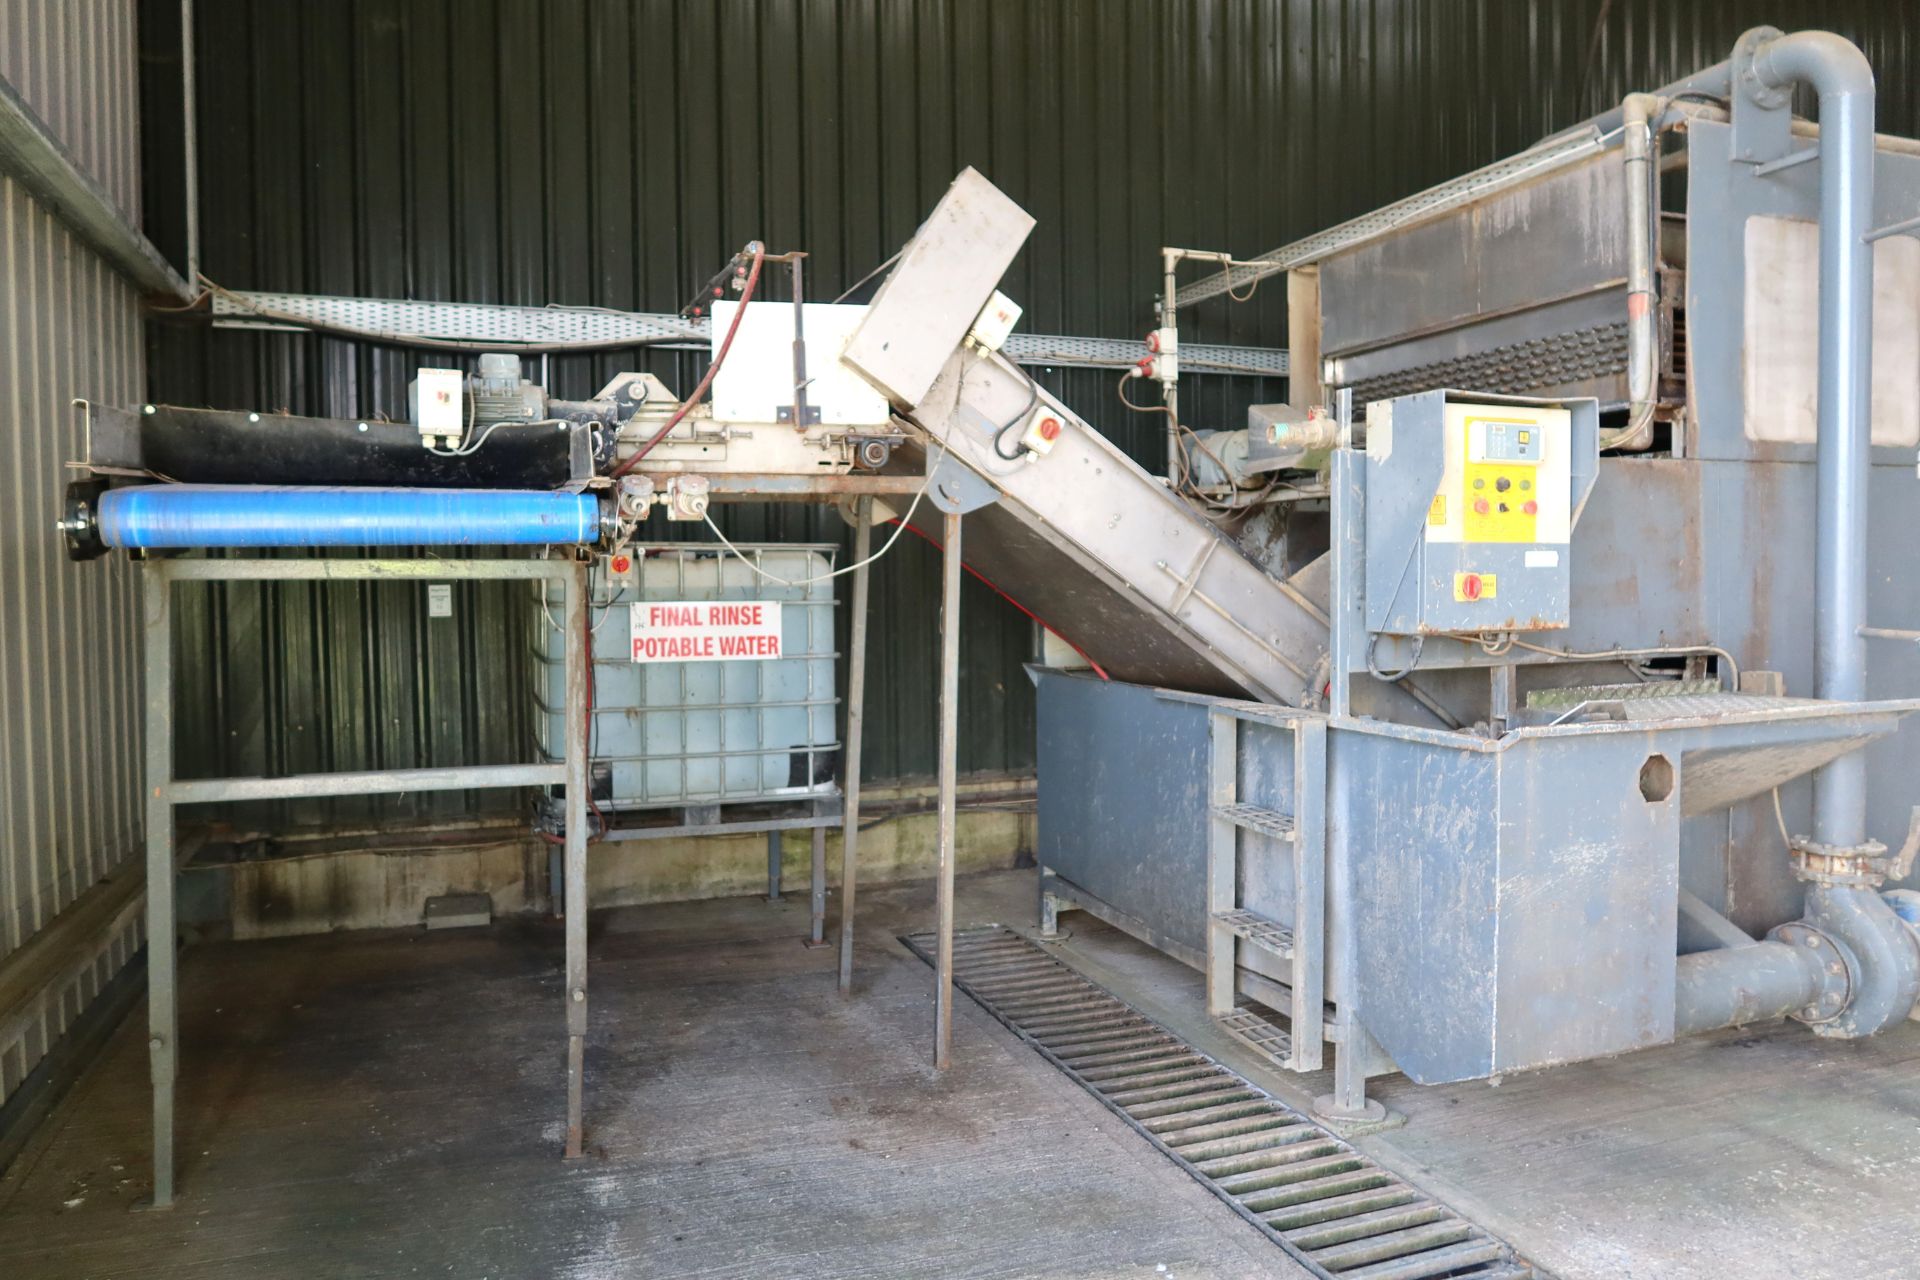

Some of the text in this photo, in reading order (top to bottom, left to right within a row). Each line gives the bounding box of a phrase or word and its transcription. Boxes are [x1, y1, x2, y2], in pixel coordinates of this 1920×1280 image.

[650, 605, 762, 626] FINAL RINSE
[633, 635, 778, 658] POTABLE WATER
